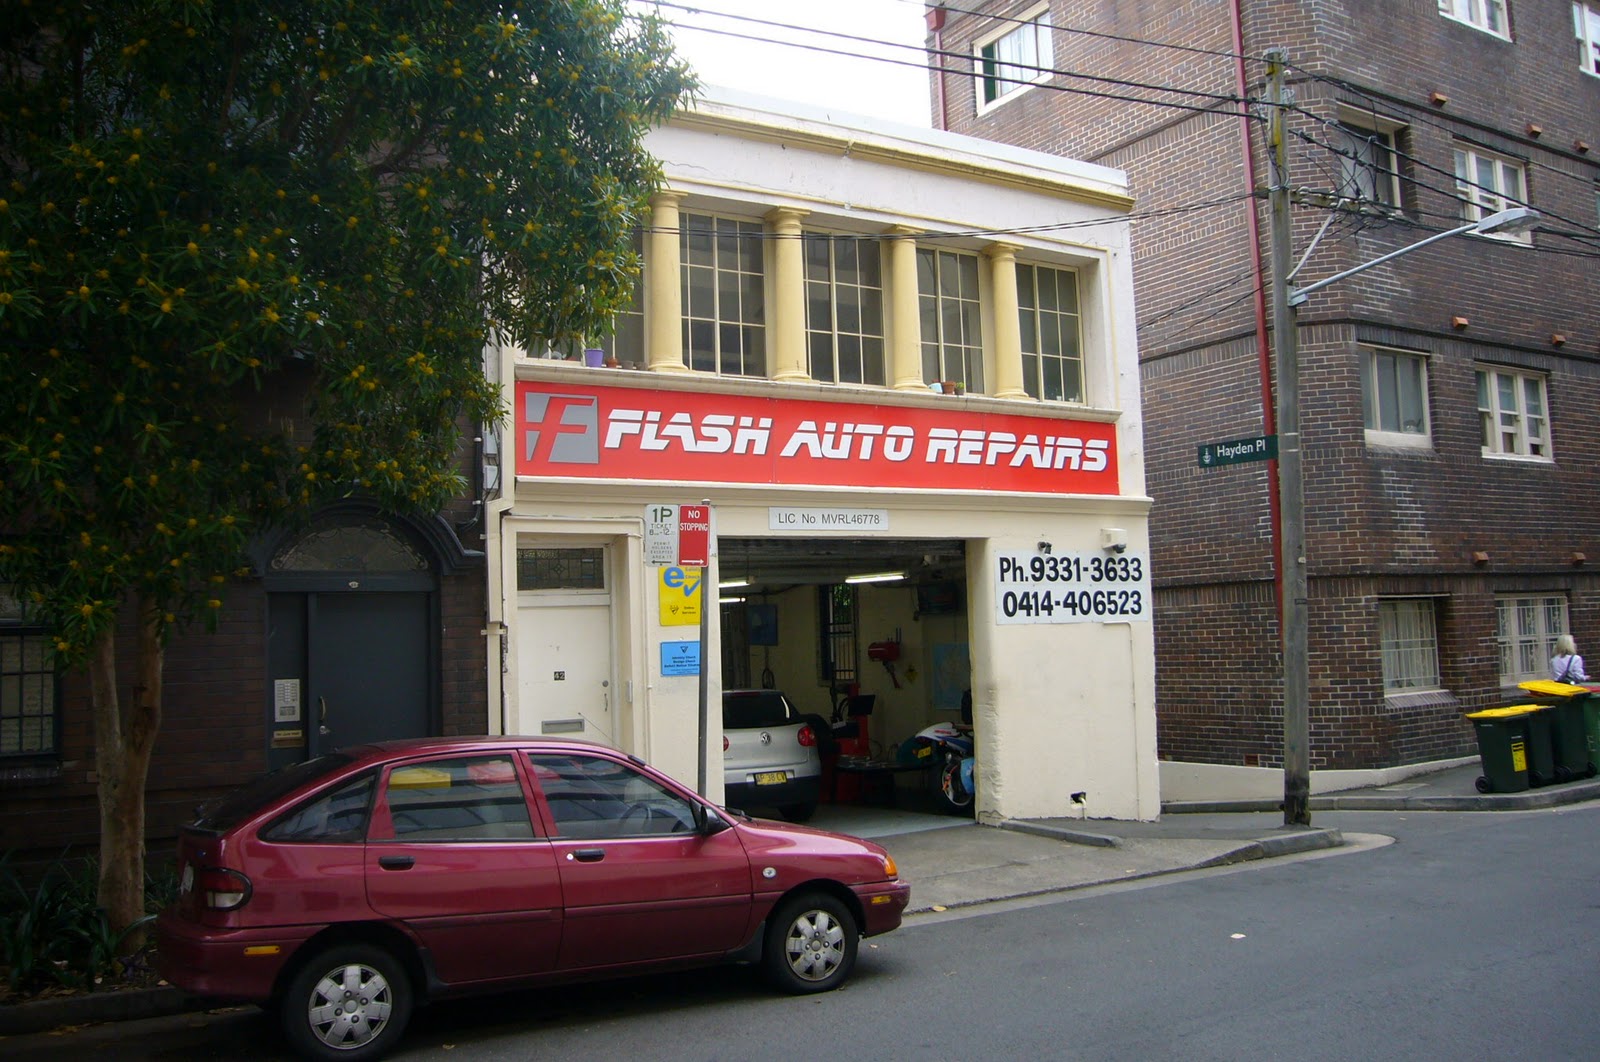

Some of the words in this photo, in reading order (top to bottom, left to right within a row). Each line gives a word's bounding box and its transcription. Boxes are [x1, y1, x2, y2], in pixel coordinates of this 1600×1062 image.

[604, 409, 772, 455] FLASH
[780, 420, 914, 462] AUTO
[925, 427, 1109, 472] REPAIRS
[1216, 443, 1254, 459] Hayden
[1256, 439, 1266, 452] Pl
[652, 506, 673, 523] 1P
[688, 510, 701, 519] NO
[821, 513, 880, 525] MVRL46778
[680, 522, 709, 531] STOPPING
[1003, 589, 1142, 617] 0414-406523
